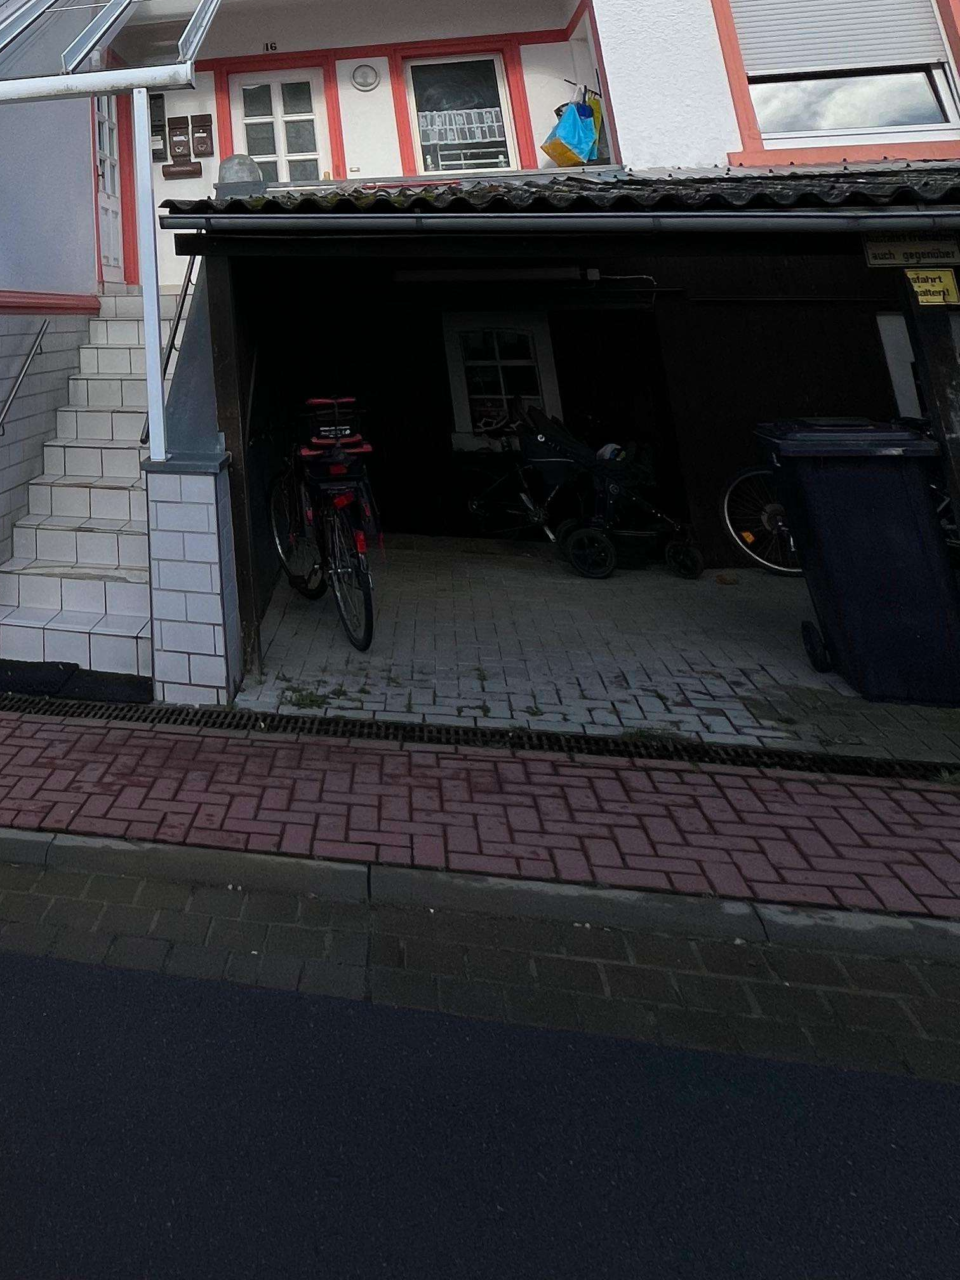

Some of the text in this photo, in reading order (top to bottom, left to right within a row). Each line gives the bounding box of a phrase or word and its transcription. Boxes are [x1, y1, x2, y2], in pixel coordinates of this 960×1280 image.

[265, 42, 277, 52] 16
[871, 248, 956, 263] auch gegenüber
